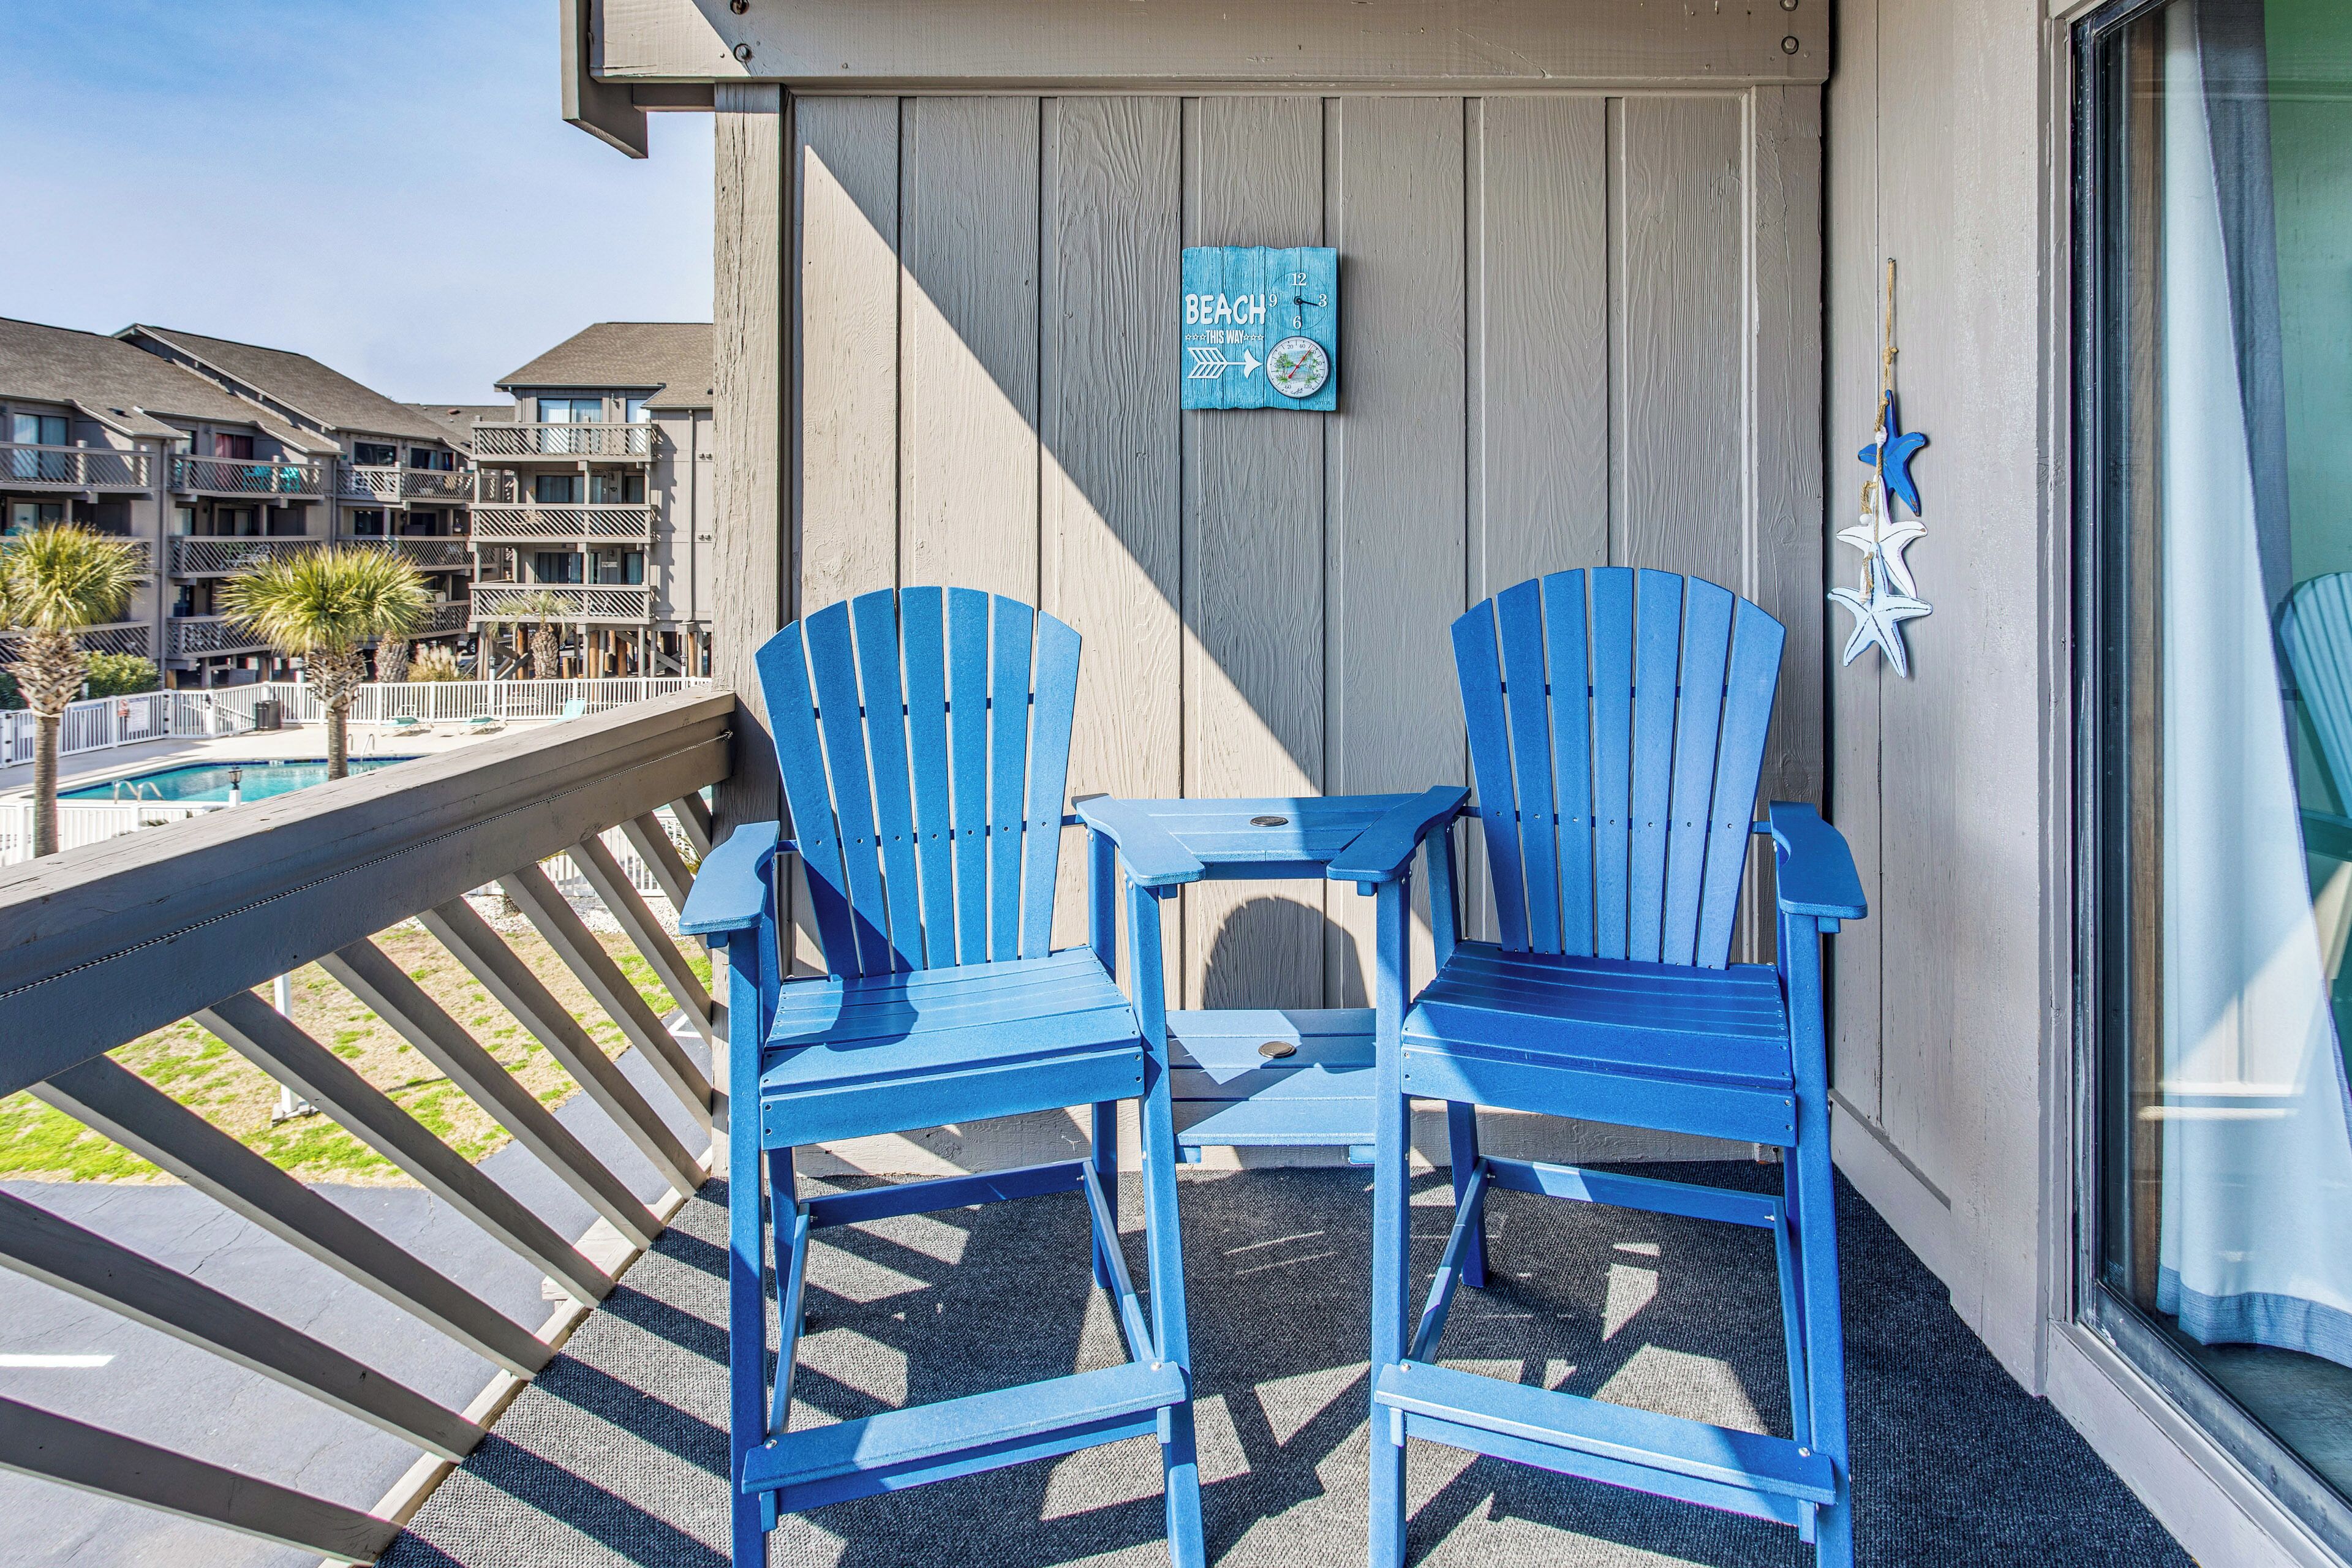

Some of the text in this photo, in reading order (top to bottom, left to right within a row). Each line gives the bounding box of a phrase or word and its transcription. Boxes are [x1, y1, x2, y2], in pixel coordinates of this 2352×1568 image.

[1292, 273, 1307, 286] 12
[1269, 294, 1278, 307] 9
[1318, 294, 1327, 307] 3
[1185, 293, 1267, 325] BEACH
[1293, 316, 1303, 329] 6
[1206, 330, 1244, 344] THIS WAY
